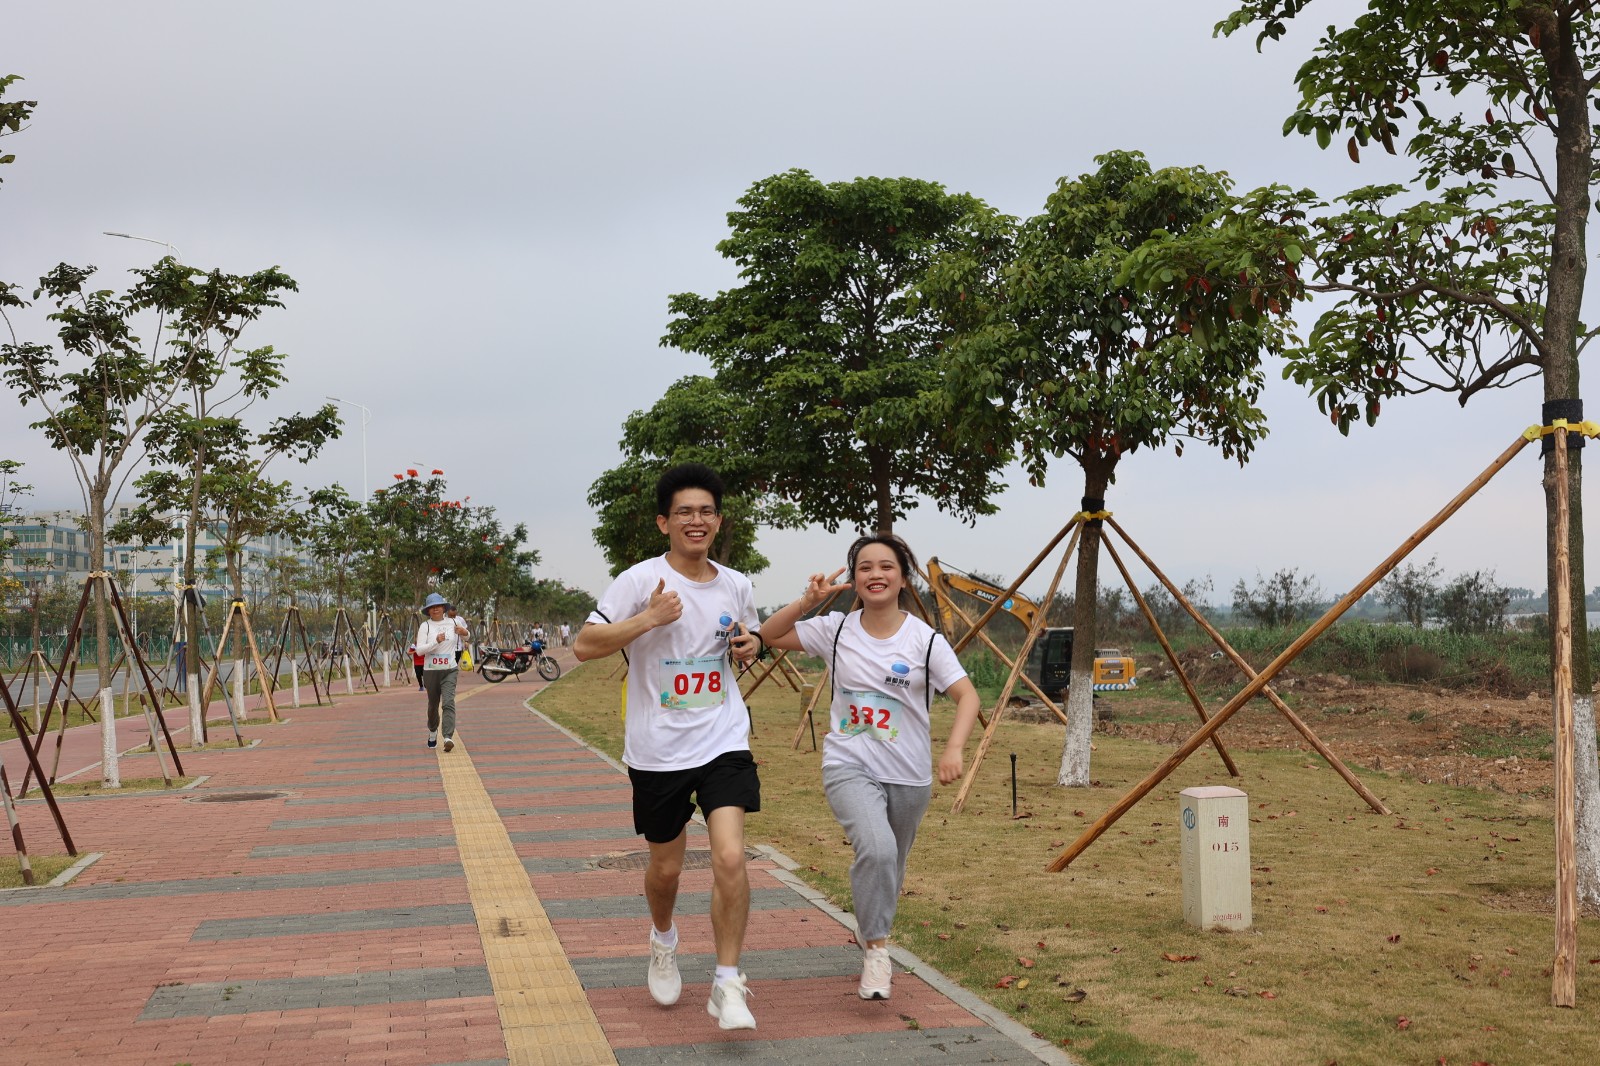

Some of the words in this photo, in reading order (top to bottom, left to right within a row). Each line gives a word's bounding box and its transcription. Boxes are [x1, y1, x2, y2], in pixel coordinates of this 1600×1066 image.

[976, 590, 996, 601] SANY
[432, 657, 449, 665] 058
[673, 671, 722, 696] 078
[849, 704, 891, 730] 332
[1217, 815, 1229, 828] 南
[1212, 842, 1239, 853] 015
